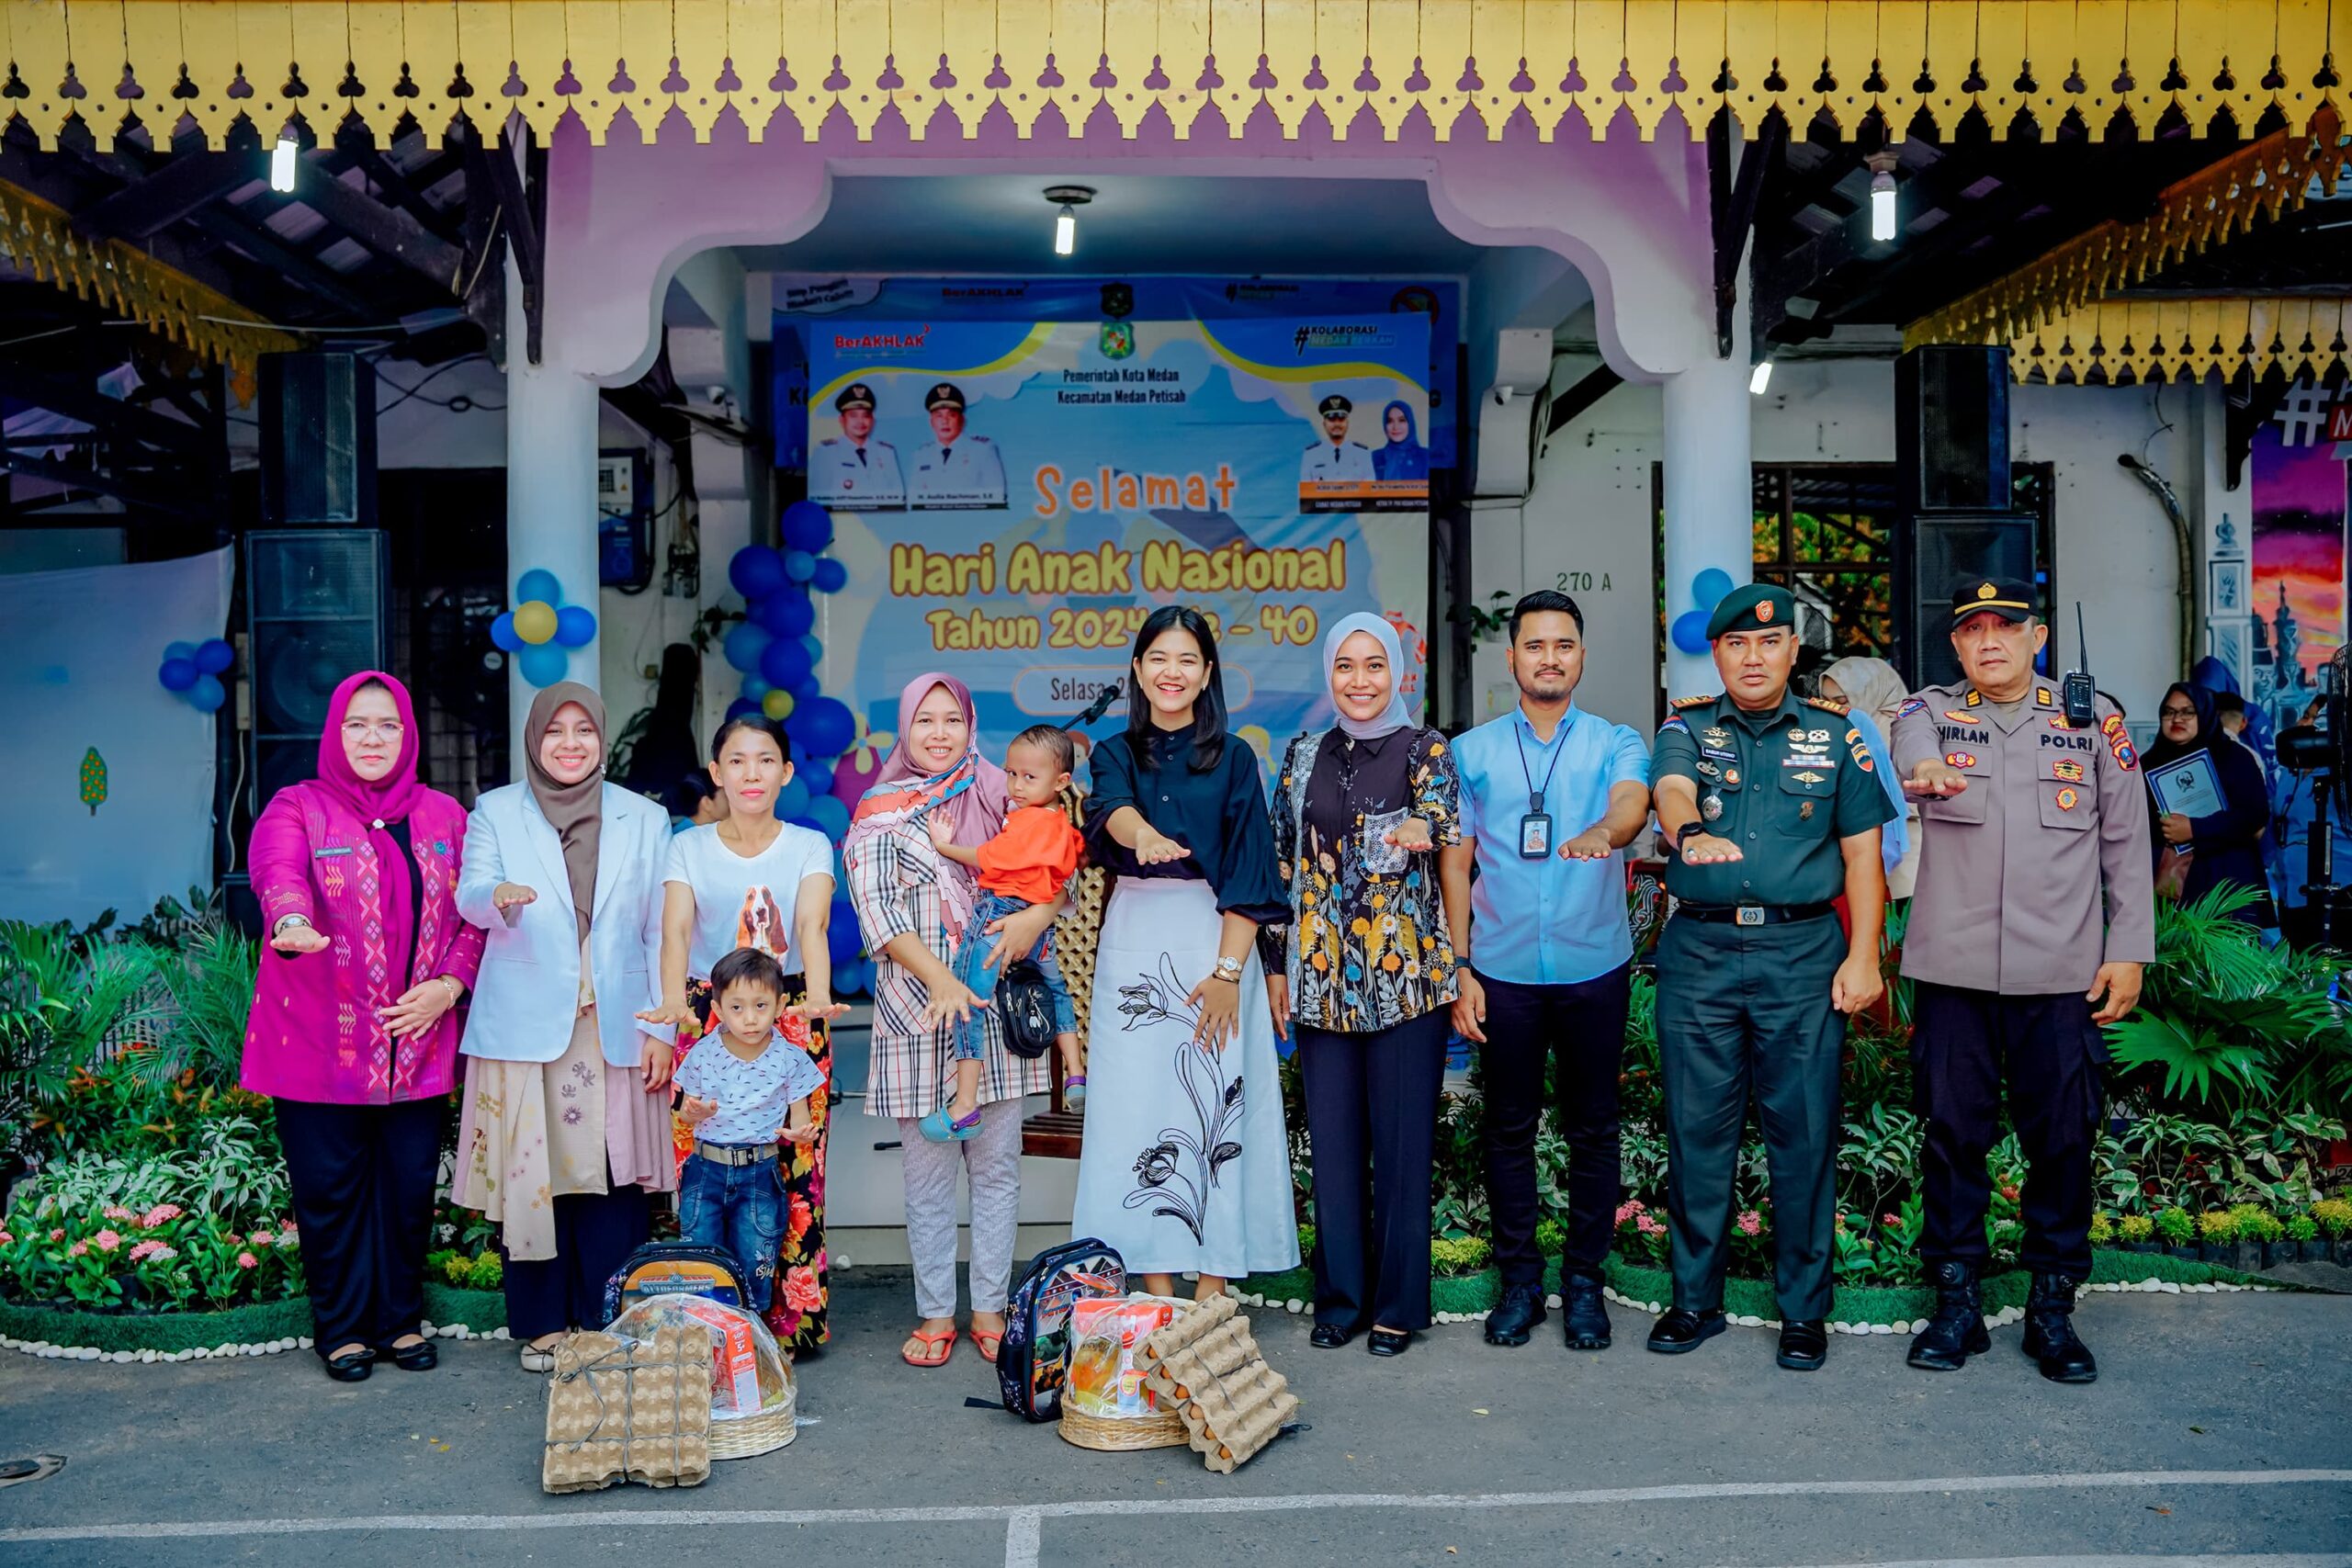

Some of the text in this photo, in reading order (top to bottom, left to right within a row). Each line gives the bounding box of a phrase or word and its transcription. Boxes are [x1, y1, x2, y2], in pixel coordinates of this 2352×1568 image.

[834, 335, 925, 348] BerAKHLAK
[1063, 368, 1180, 383] Pemerintah Kota Medan
[1057, 389, 1186, 404] Kecamatan Medan Petisah
[1036, 465, 1236, 516] Selamat
[889, 537, 1347, 597] Hari Anak Nasional
[1556, 572, 1611, 591] 270 A
[924, 608, 1042, 650] Tahun
[1260, 604, 1317, 647] 40
[2041, 734, 2093, 751] POLRI
